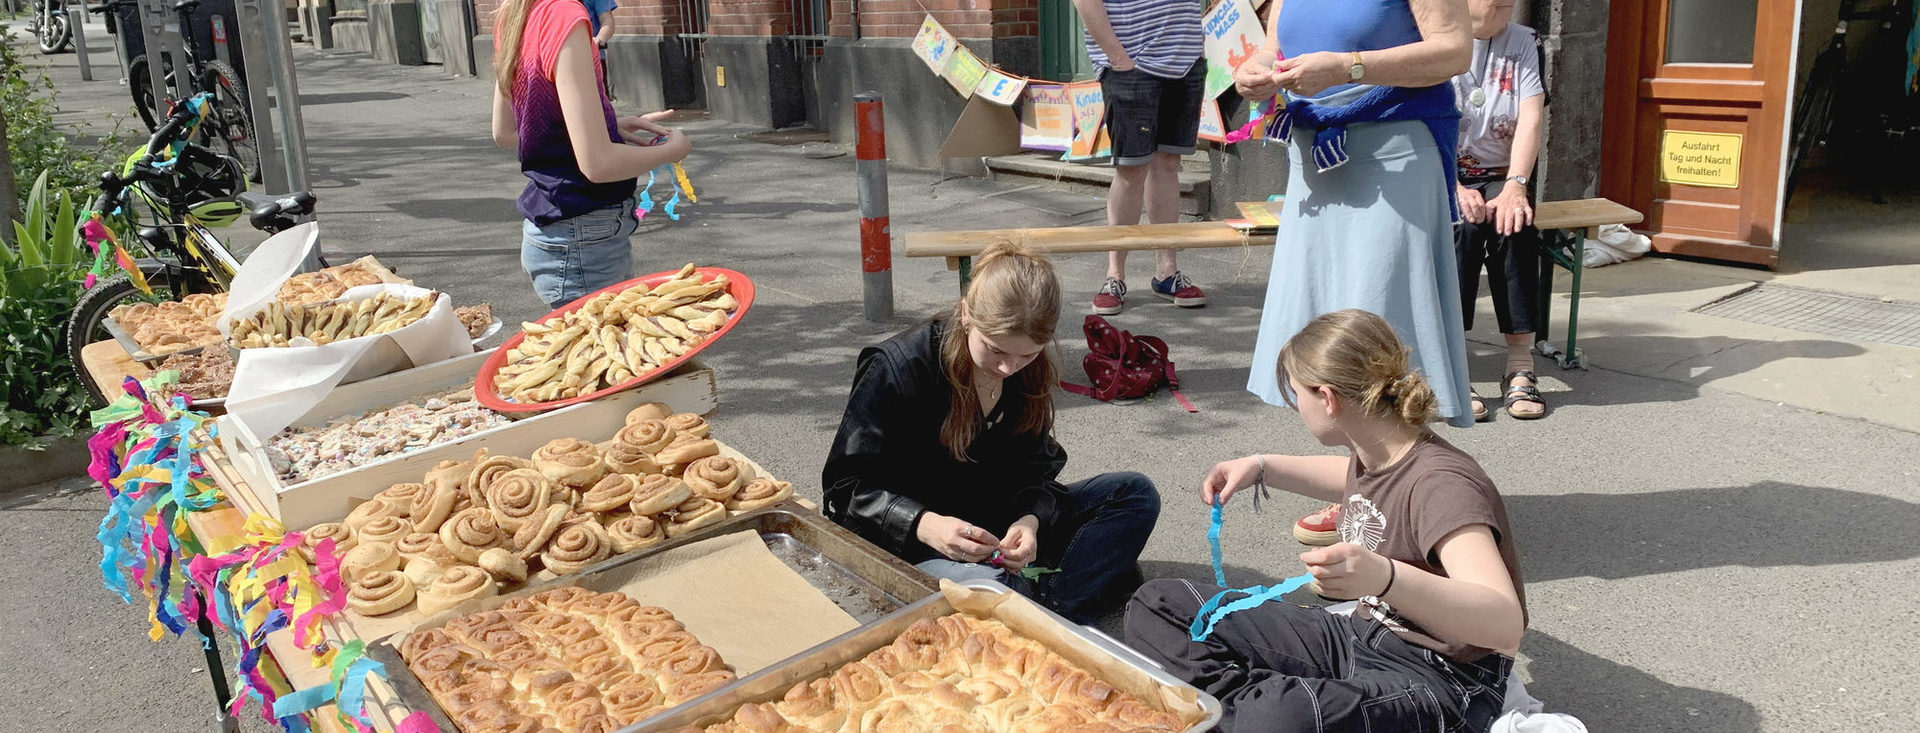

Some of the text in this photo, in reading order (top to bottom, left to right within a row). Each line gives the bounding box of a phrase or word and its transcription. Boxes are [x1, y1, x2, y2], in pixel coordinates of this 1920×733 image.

[1215, 9, 1240, 40] MASS
[1682, 141, 1720, 151] Ausfahrt
[1669, 152, 1731, 165] Tag und Nacht
[1677, 166, 1721, 176] freihalten!
